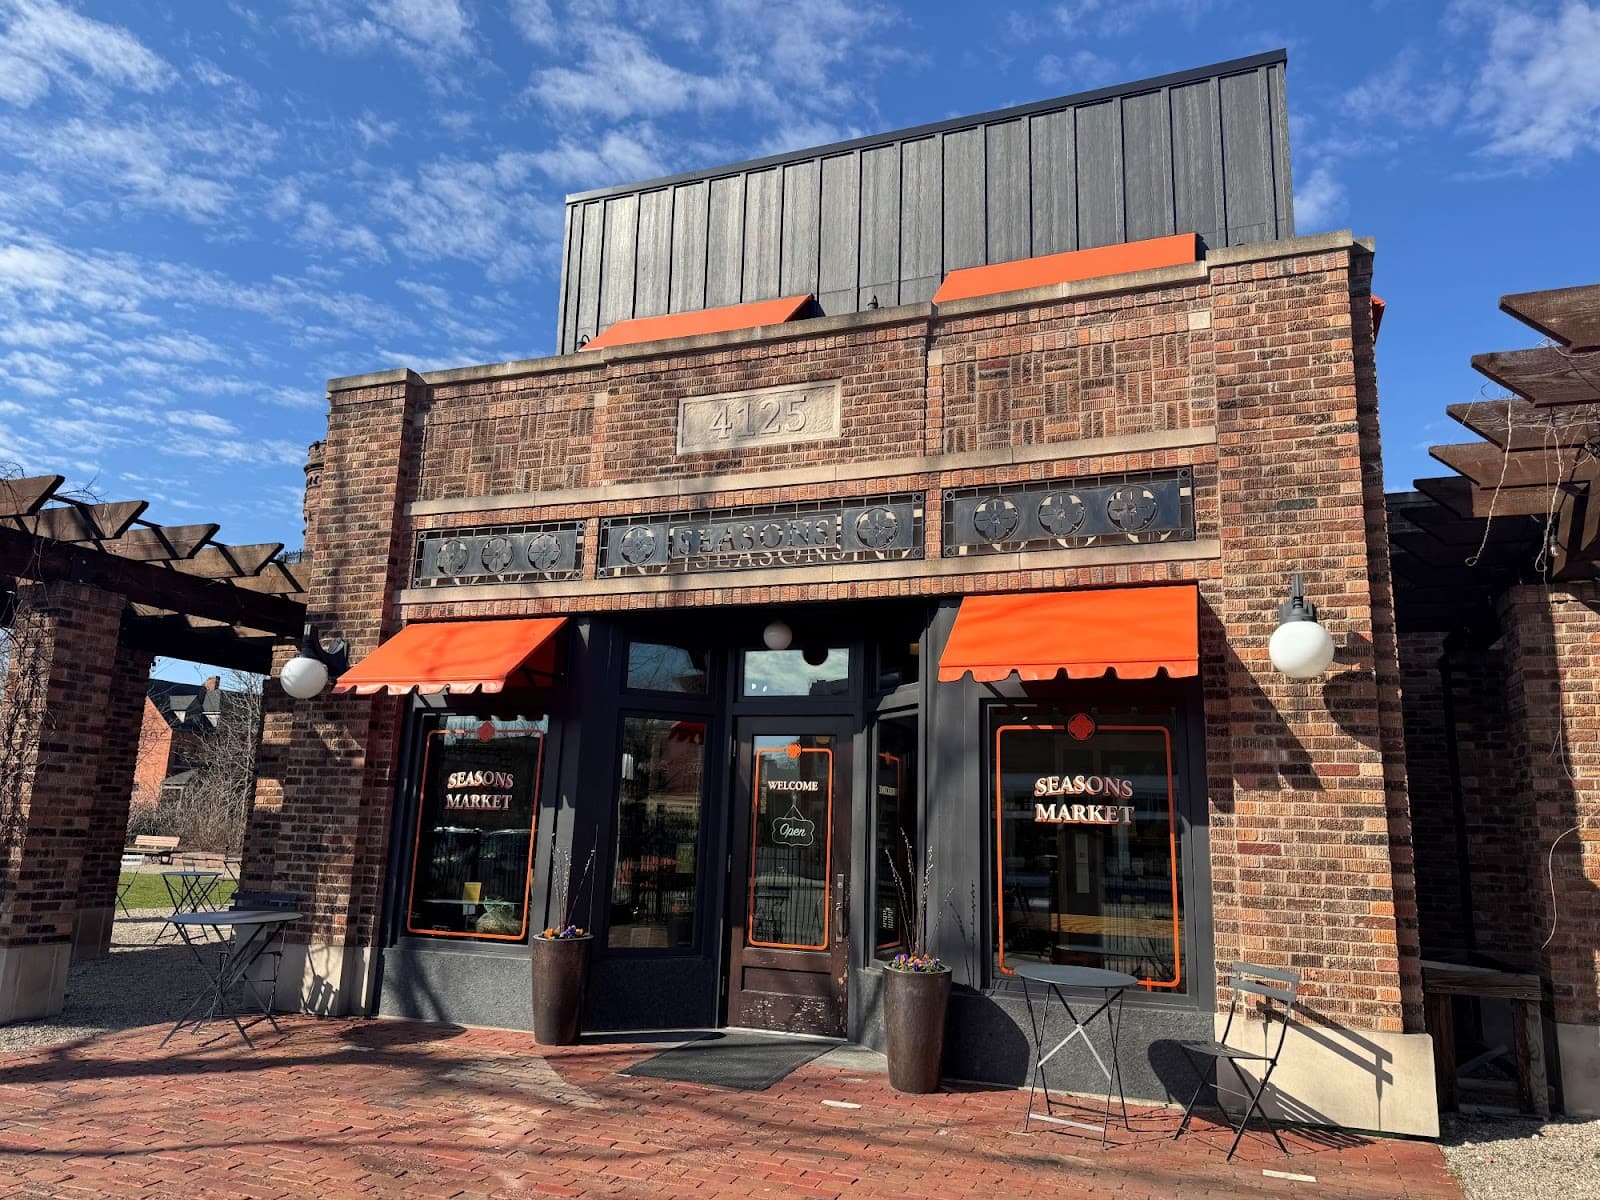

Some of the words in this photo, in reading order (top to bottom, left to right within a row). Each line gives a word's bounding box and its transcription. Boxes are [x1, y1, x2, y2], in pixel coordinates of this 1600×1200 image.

[709, 395, 807, 439] 4125
[679, 518, 829, 555] SEASONS
[447, 770, 514, 790] SEASONS
[767, 780, 819, 792] WELCOME
[1034, 775, 1134, 798] SEASONS
[445, 793, 513, 810] MARKET
[1035, 803, 1135, 825] MARKET
[780, 823, 807, 838] Open
